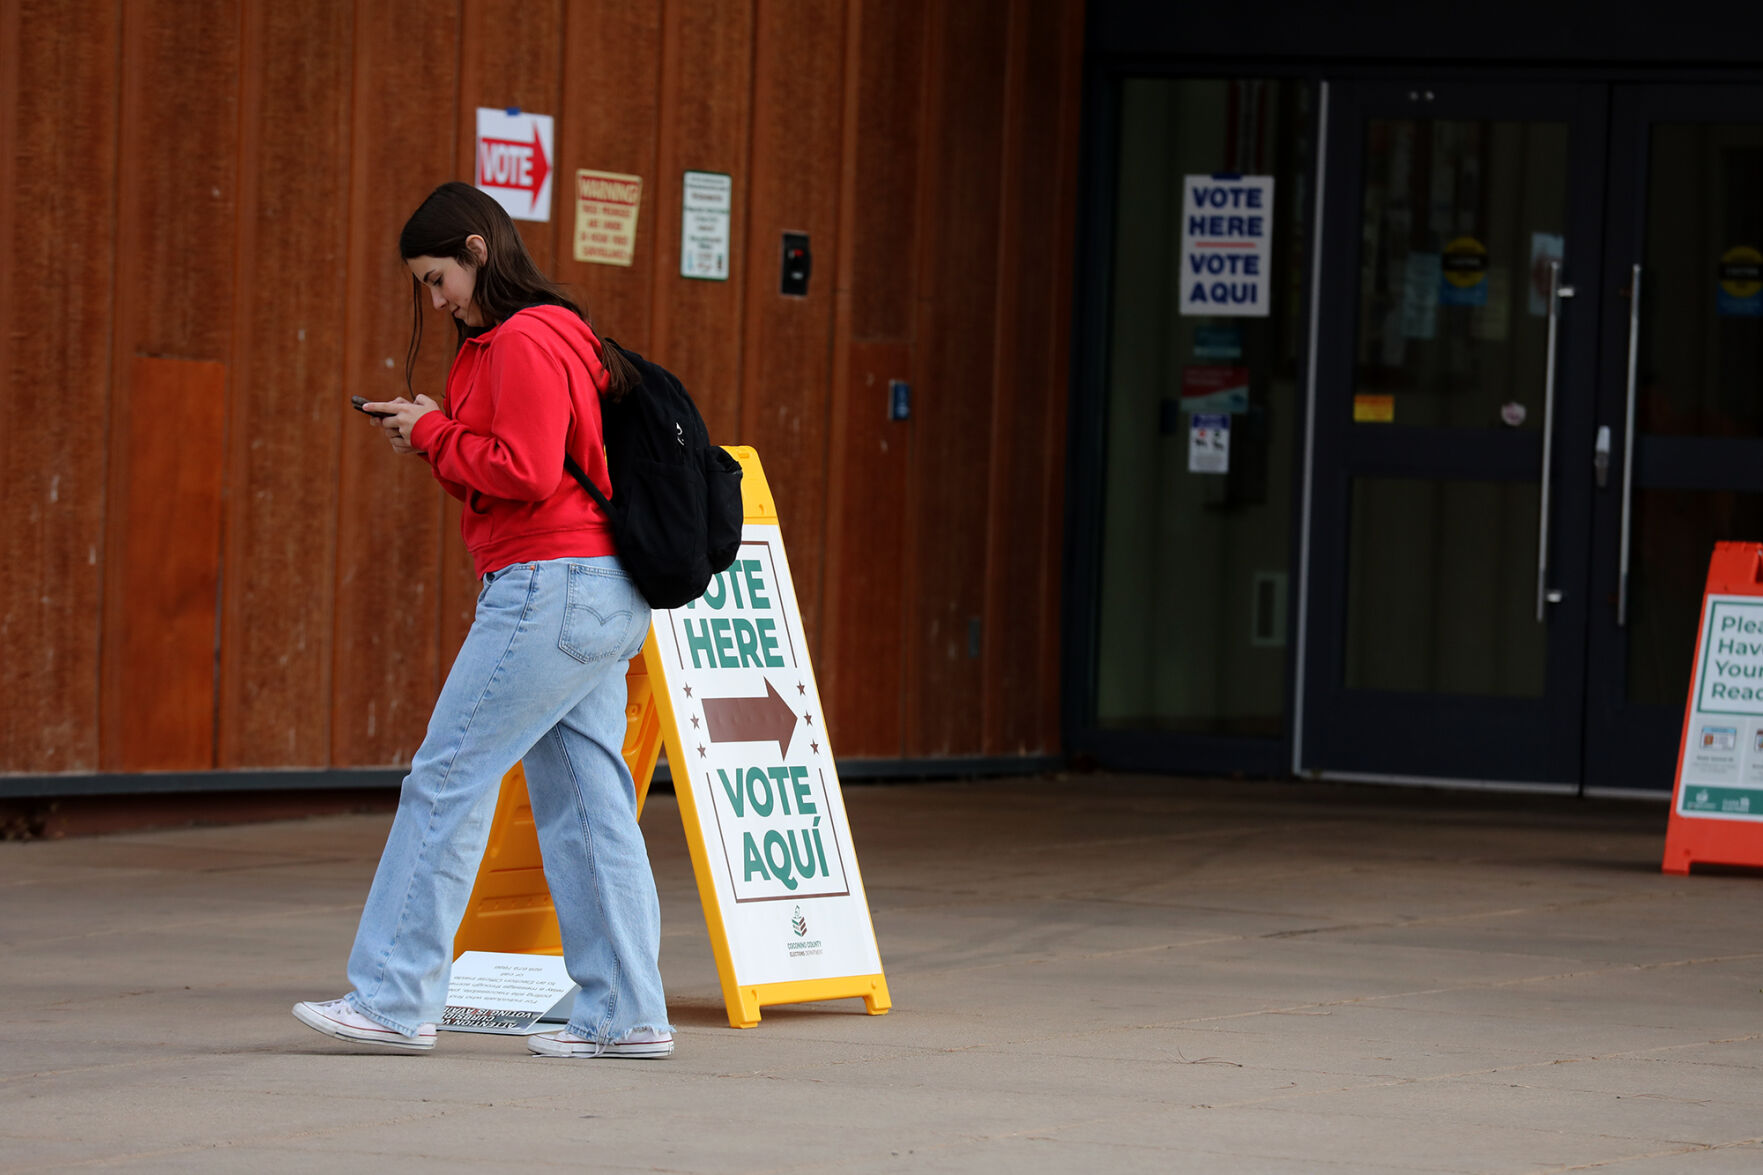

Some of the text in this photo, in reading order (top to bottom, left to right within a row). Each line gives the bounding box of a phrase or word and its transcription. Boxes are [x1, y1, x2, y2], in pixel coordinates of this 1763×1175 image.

[480, 141, 534, 187] VOTE
[1192, 186, 1263, 209] VOTE
[1189, 215, 1264, 237] HERE
[1189, 253, 1261, 276] VOTE
[1189, 281, 1258, 305] AQUI
[684, 559, 772, 610] OTE
[683, 618, 785, 669] HERE
[1718, 638, 1763, 656] Hav
[716, 765, 818, 818] VOTE
[743, 815, 830, 891] AQUÍ
[443, 1013, 496, 1022] CURBSID
[455, 1019, 518, 1028] ATTENTION
[491, 1010, 533, 1019] VOTING
